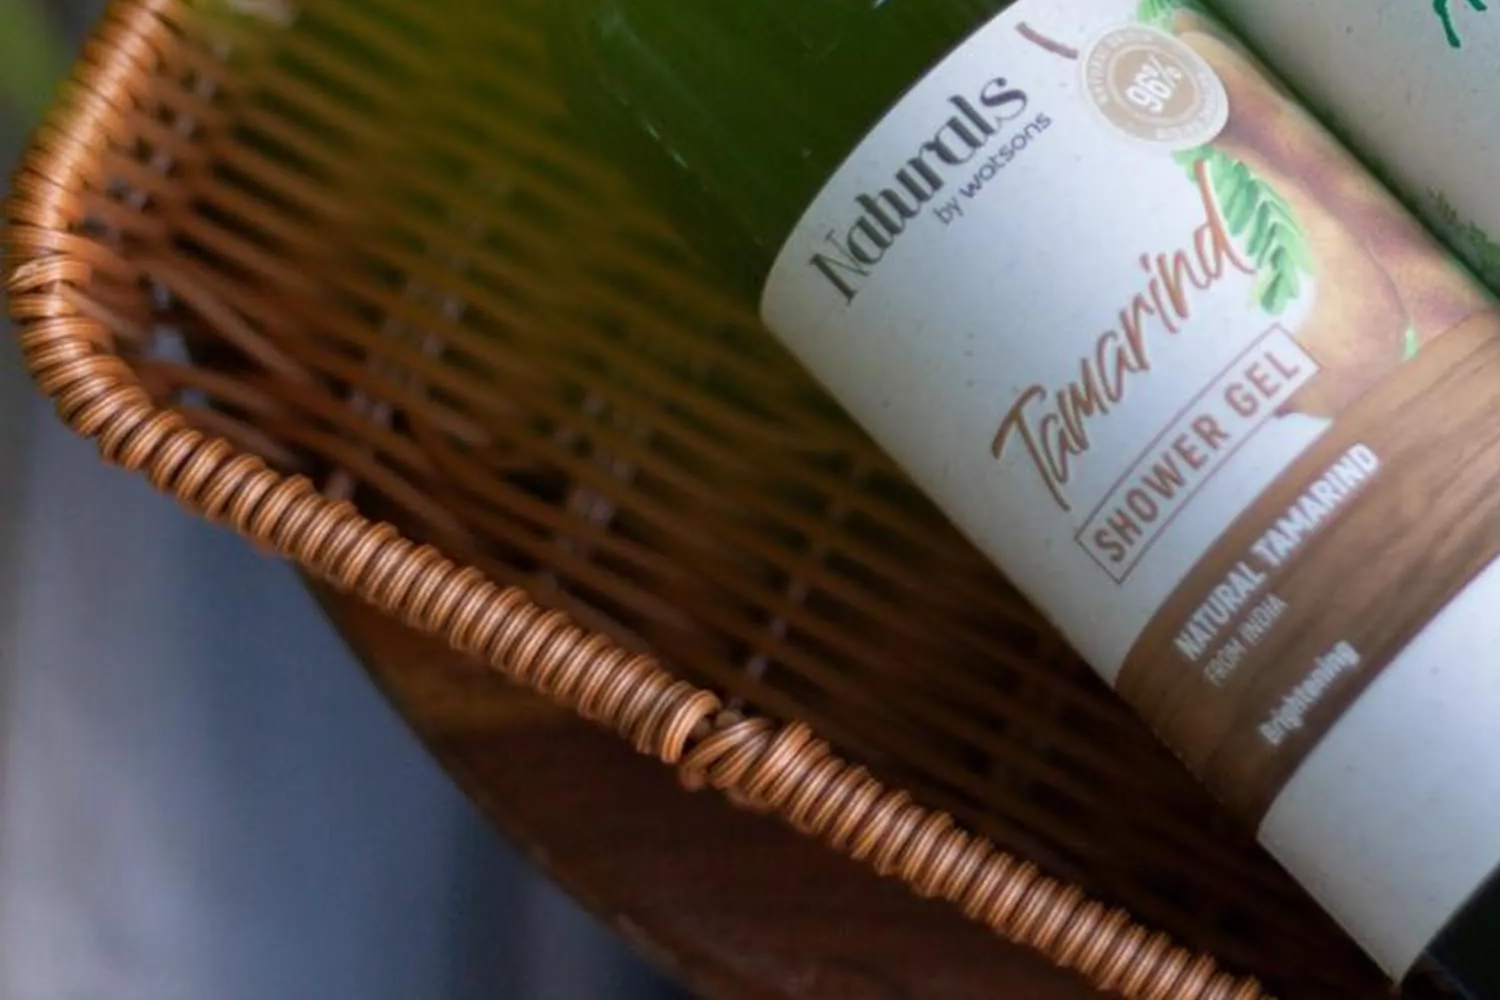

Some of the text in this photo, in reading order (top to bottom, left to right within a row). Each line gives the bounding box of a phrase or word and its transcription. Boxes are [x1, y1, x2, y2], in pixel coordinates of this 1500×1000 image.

[933, 111, 1052, 225] by watsons
[1125, 53, 1182, 113] 96%
[809, 77, 1027, 306] Naturals
[991, 159, 1256, 512] Tamarind
[1093, 351, 1299, 563] SHOWER GEL
[1174, 443, 1379, 661] NATURAL TAMARIND
